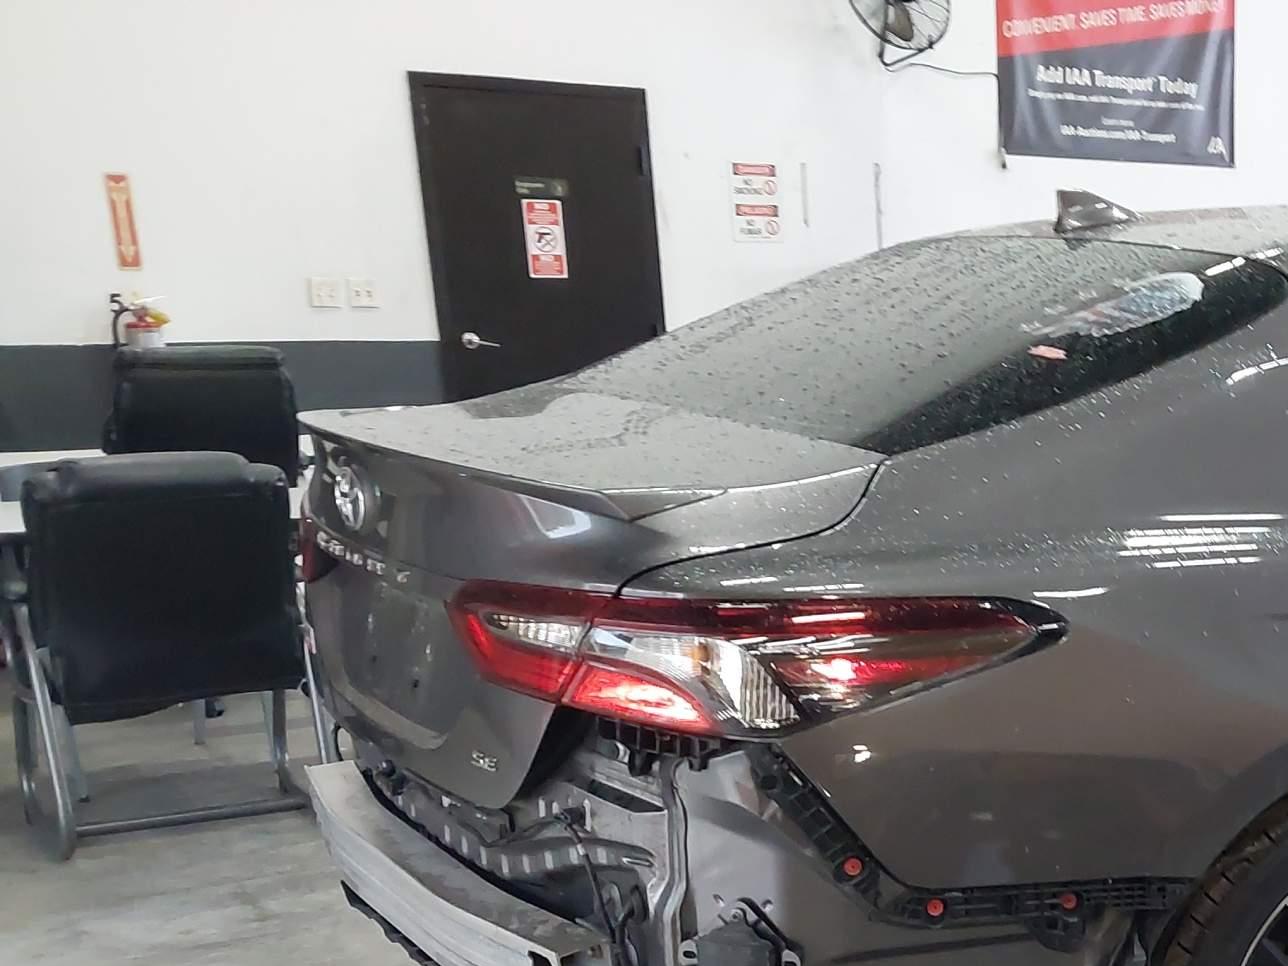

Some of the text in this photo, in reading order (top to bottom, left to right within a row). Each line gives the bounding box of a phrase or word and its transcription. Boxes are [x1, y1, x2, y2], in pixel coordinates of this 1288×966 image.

[1079, 8, 1117, 29] SAVES
[1036, 65, 1063, 84] Add
[1065, 67, 1092, 87] IAA
[1158, 76, 1199, 99] Today
[471, 750, 497, 771] SE
